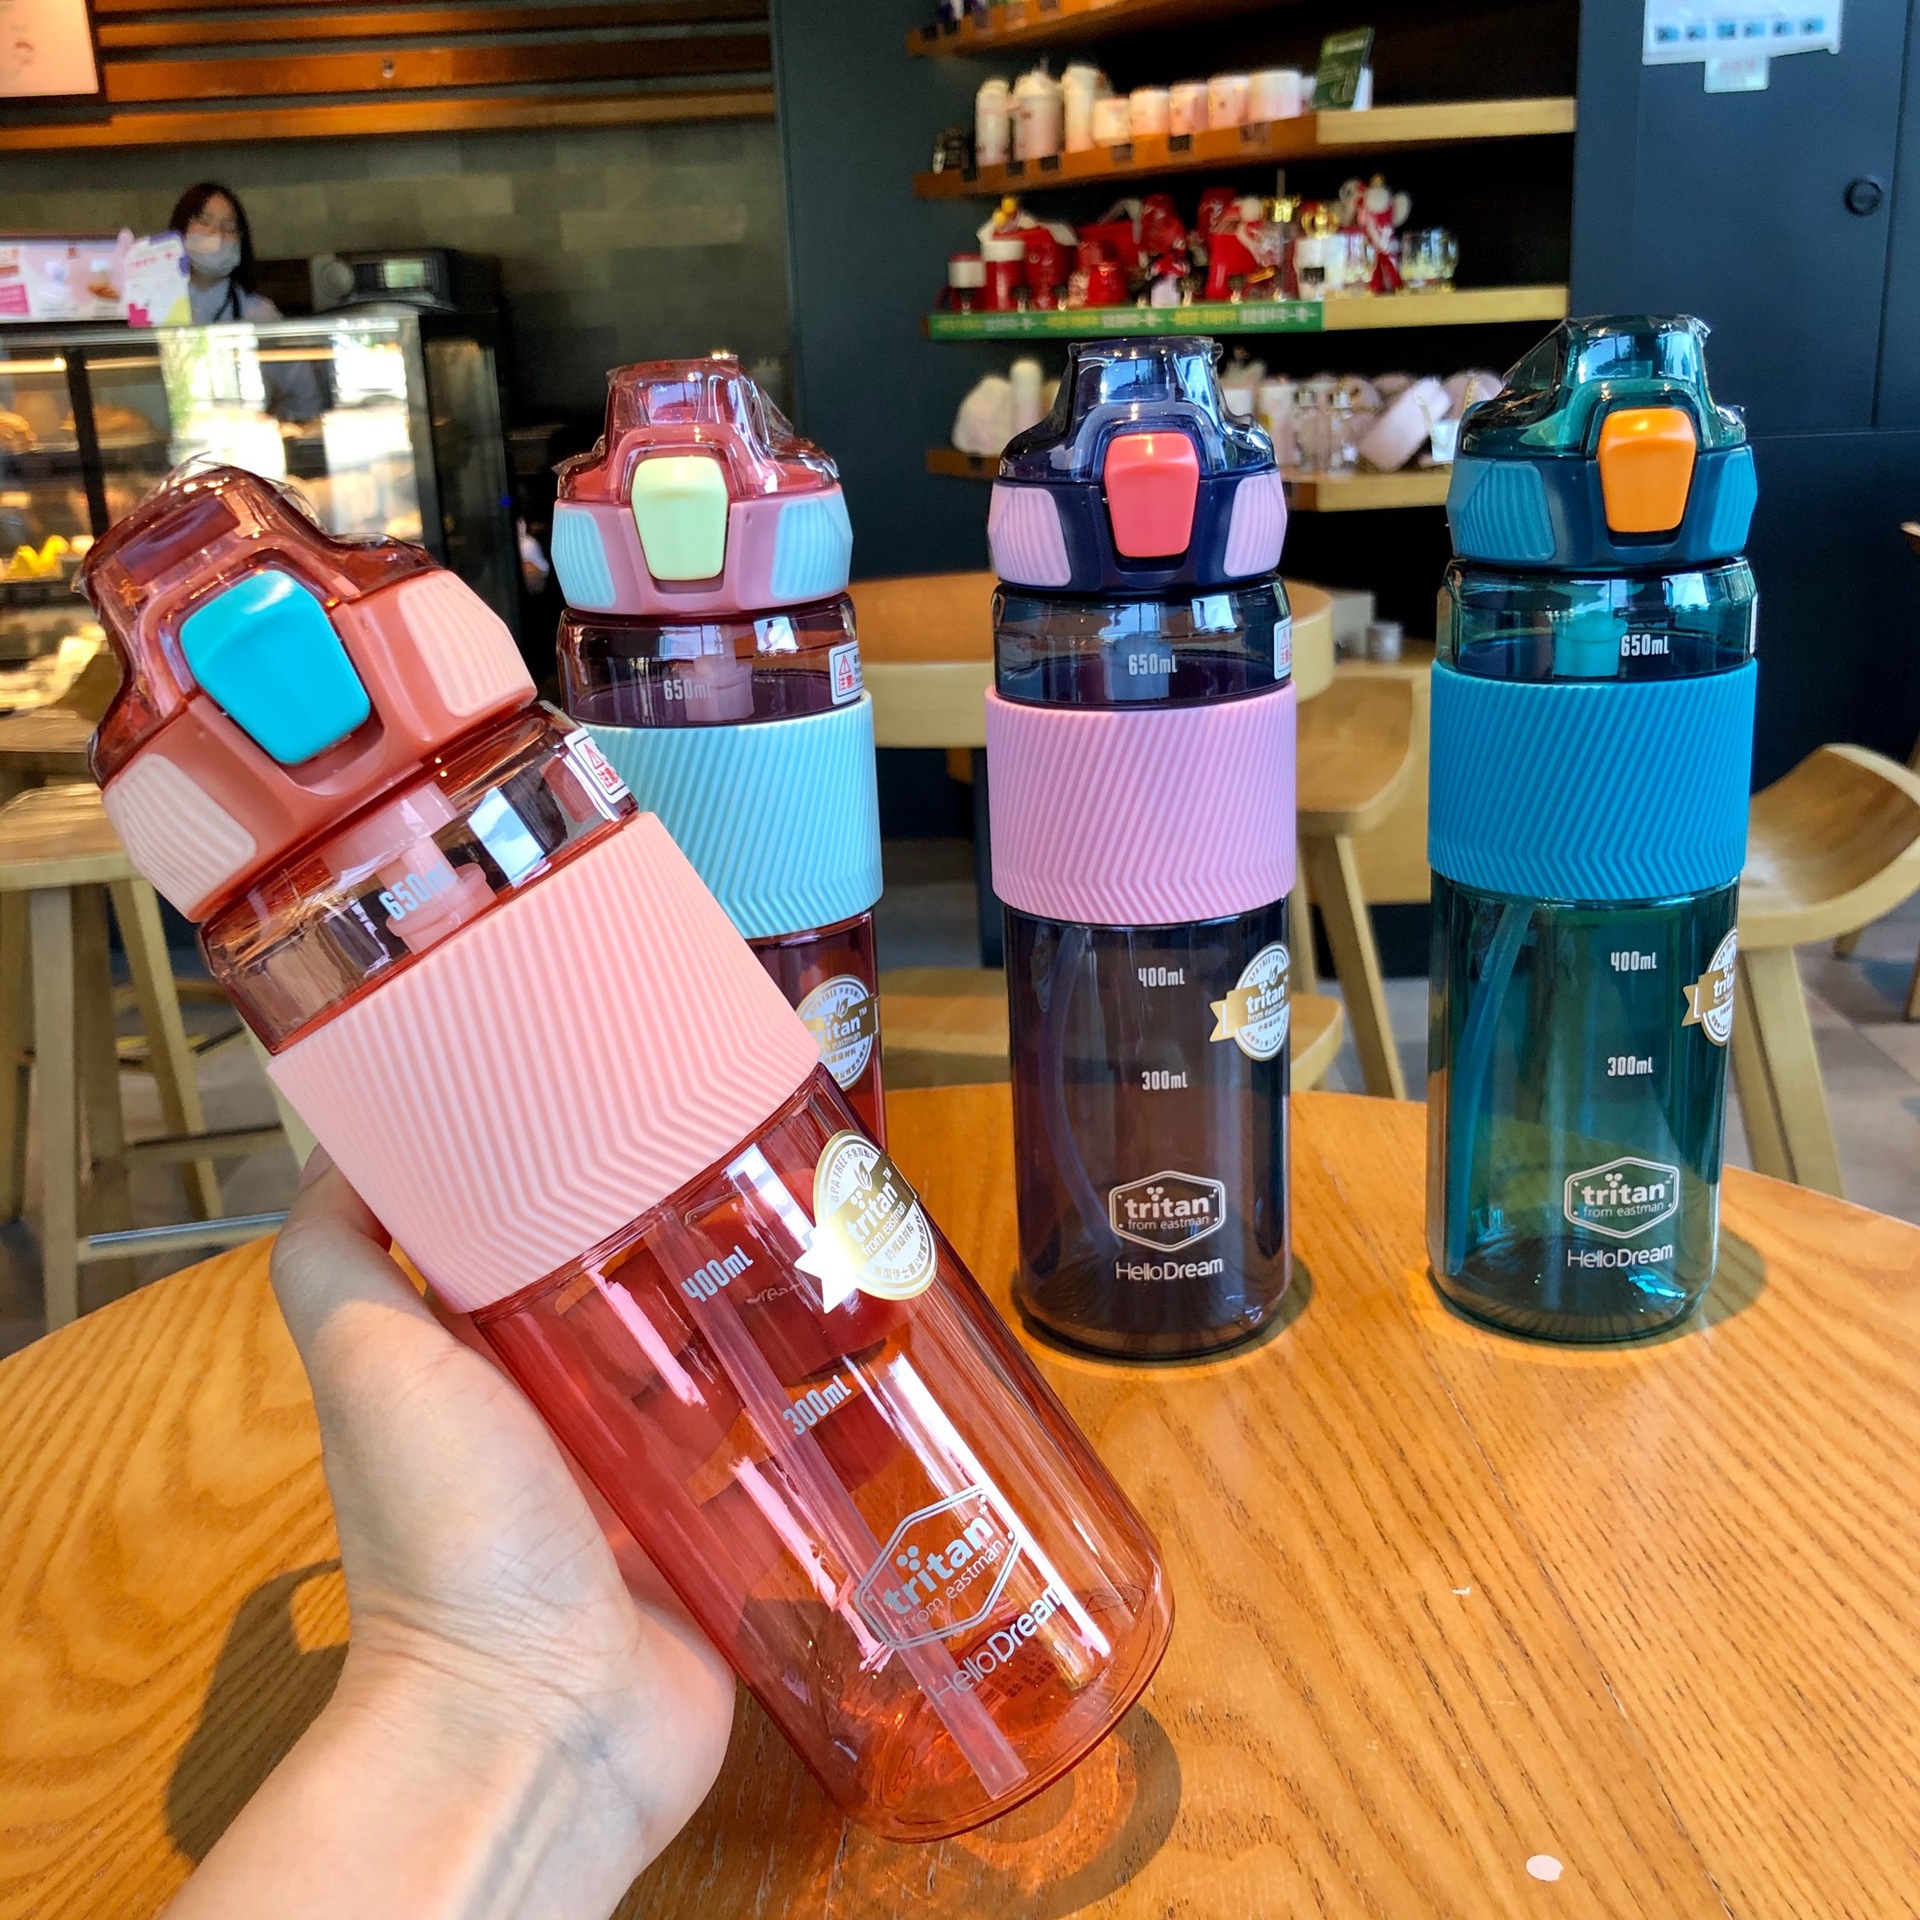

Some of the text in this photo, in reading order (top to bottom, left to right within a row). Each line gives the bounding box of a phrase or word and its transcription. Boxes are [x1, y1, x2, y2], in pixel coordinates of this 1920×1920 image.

[1246, 981, 1285, 1014] tritan
[833, 1154, 848, 1179] FREE
[1124, 1187, 1209, 1219] tritan
[1581, 1173, 1665, 1206] tritan
[846, 1182, 898, 1244] tritan
[1128, 1215, 1209, 1231] from eastman
[1583, 1202, 1664, 1218] from eastman
[861, 1232, 885, 1257] from
[1567, 1244, 1673, 1268] HelloDream
[1115, 1258, 1224, 1280] HelloDream
[883, 1516, 994, 1615] tritan
[903, 1538, 1006, 1631] from eastman
[928, 1586, 1064, 1707] HelloDream
